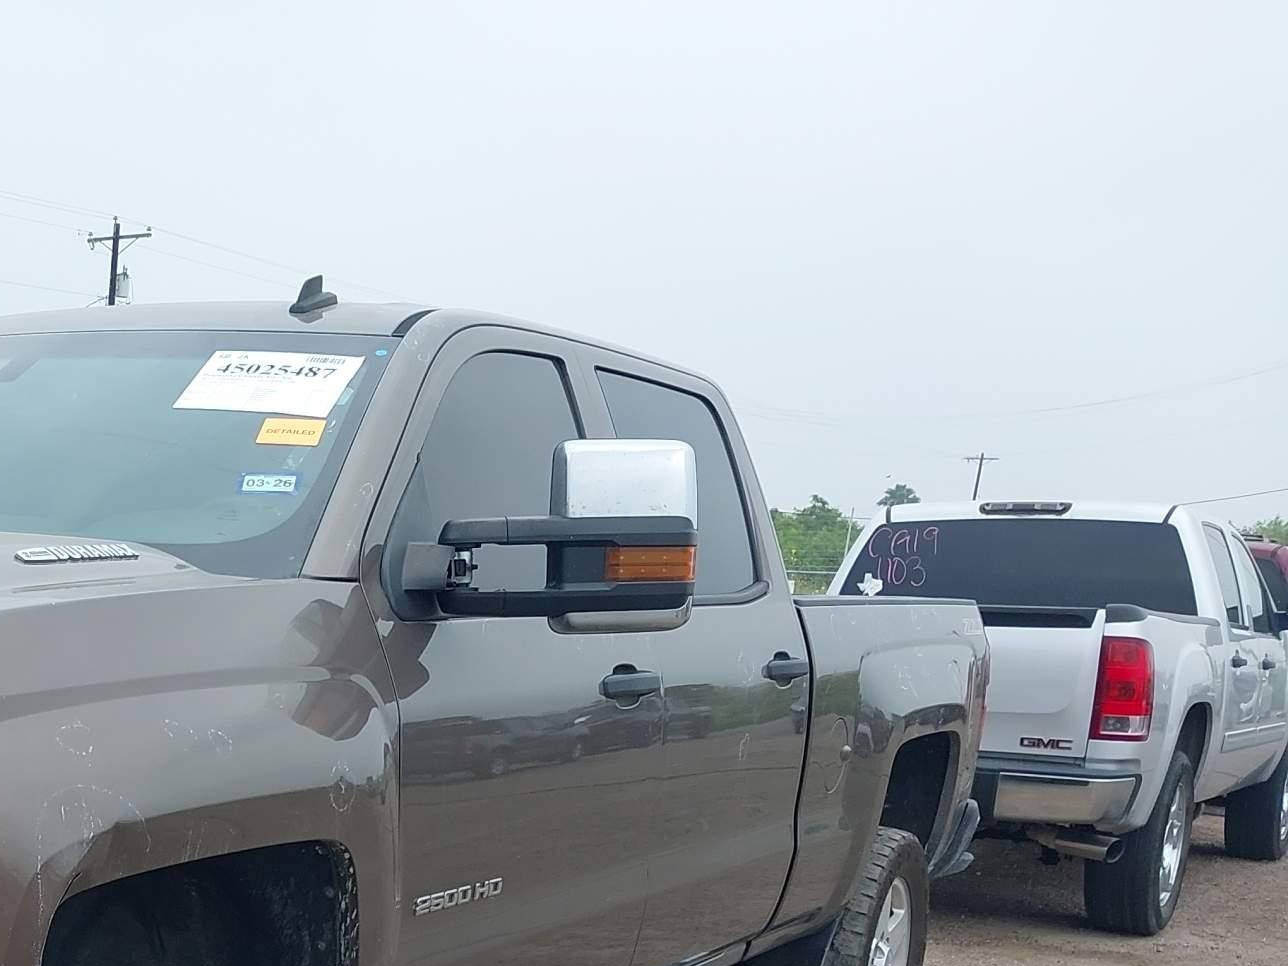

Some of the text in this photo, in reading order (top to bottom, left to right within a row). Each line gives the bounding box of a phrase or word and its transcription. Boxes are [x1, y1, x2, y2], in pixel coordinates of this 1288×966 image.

[217, 363, 337, 379] 45025487
[265, 428, 316, 436] DETAILED
[46, 543, 140, 561] DURAMAX
[1019, 736, 1074, 751] GMC
[414, 877, 503, 916] 2500 HD
